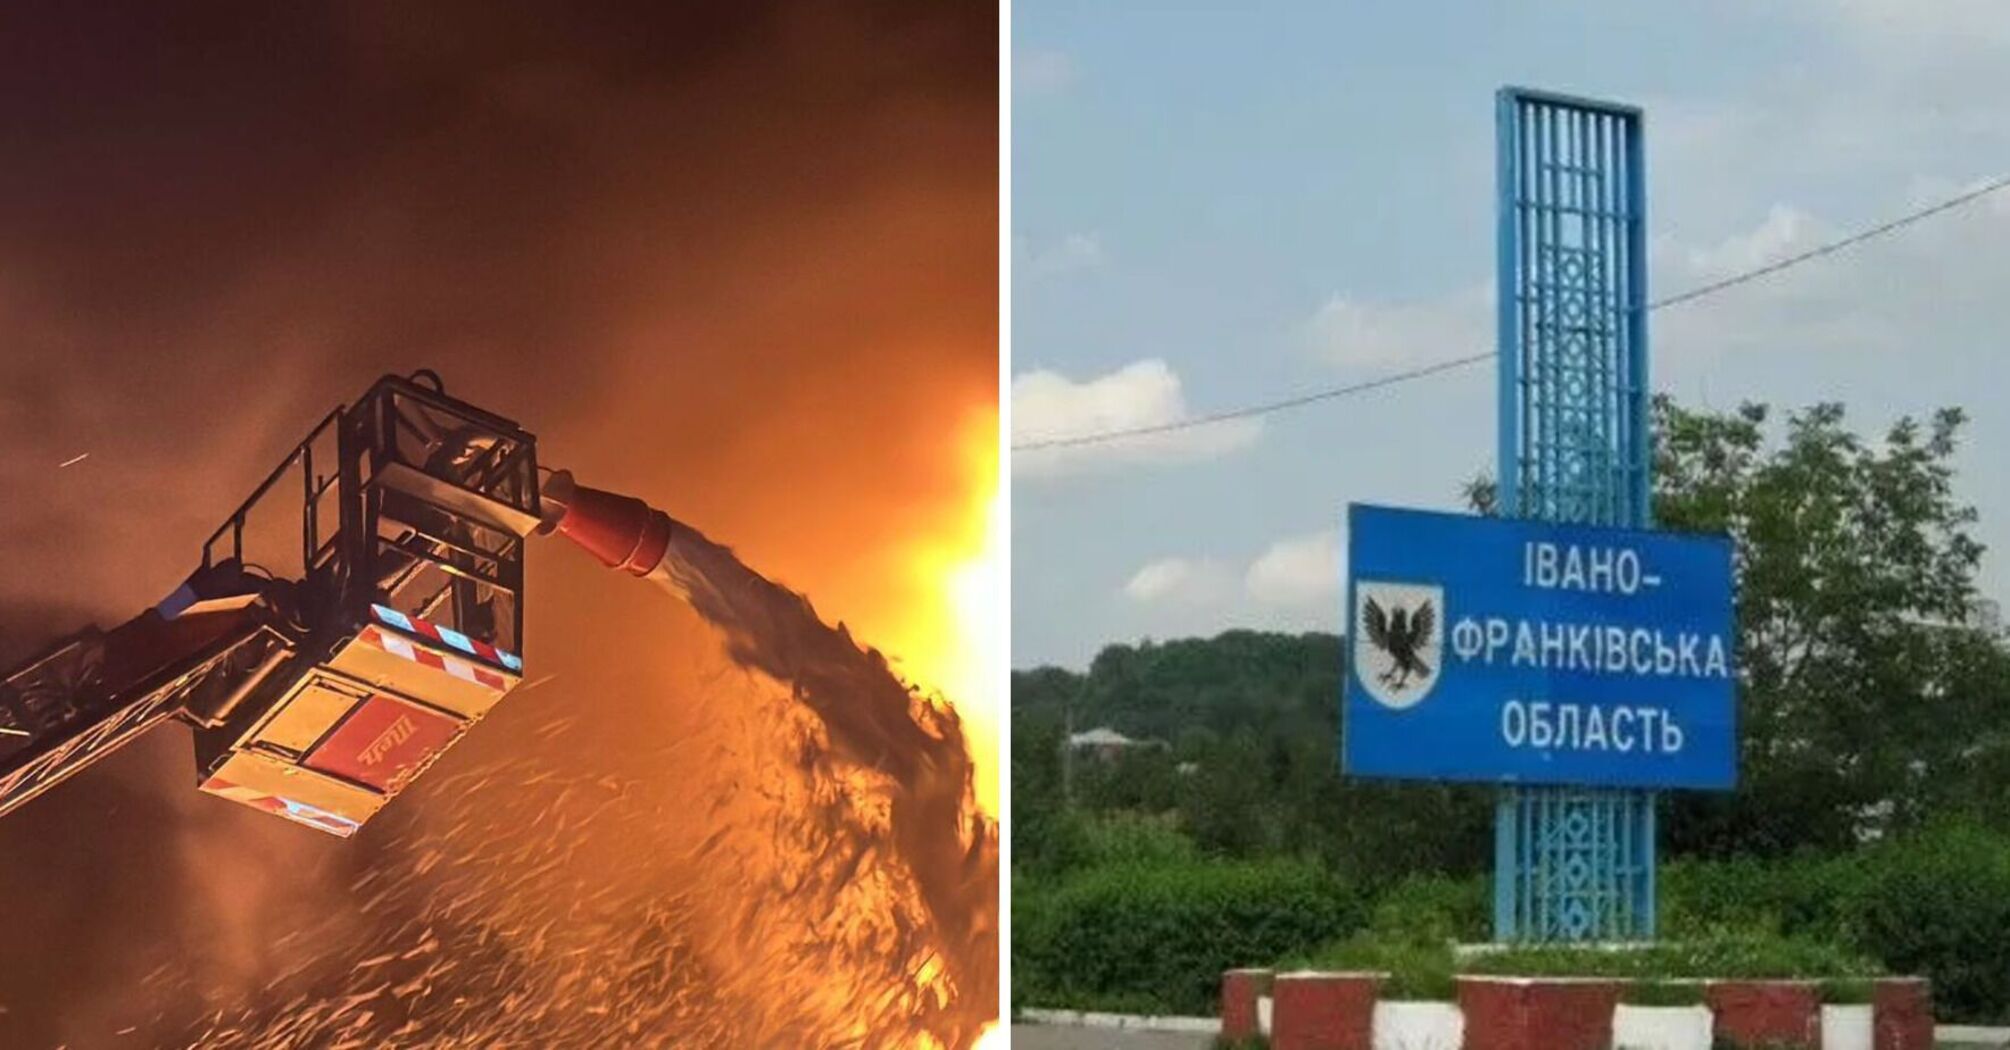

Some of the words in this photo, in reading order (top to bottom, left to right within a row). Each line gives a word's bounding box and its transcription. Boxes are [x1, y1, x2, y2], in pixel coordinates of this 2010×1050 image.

[1523, 542, 1661, 594] ІВАНО-
[1452, 617, 1728, 678] ФРАНКІВСЬКА
[1501, 700, 1684, 752] ОБЛАСТЬ
